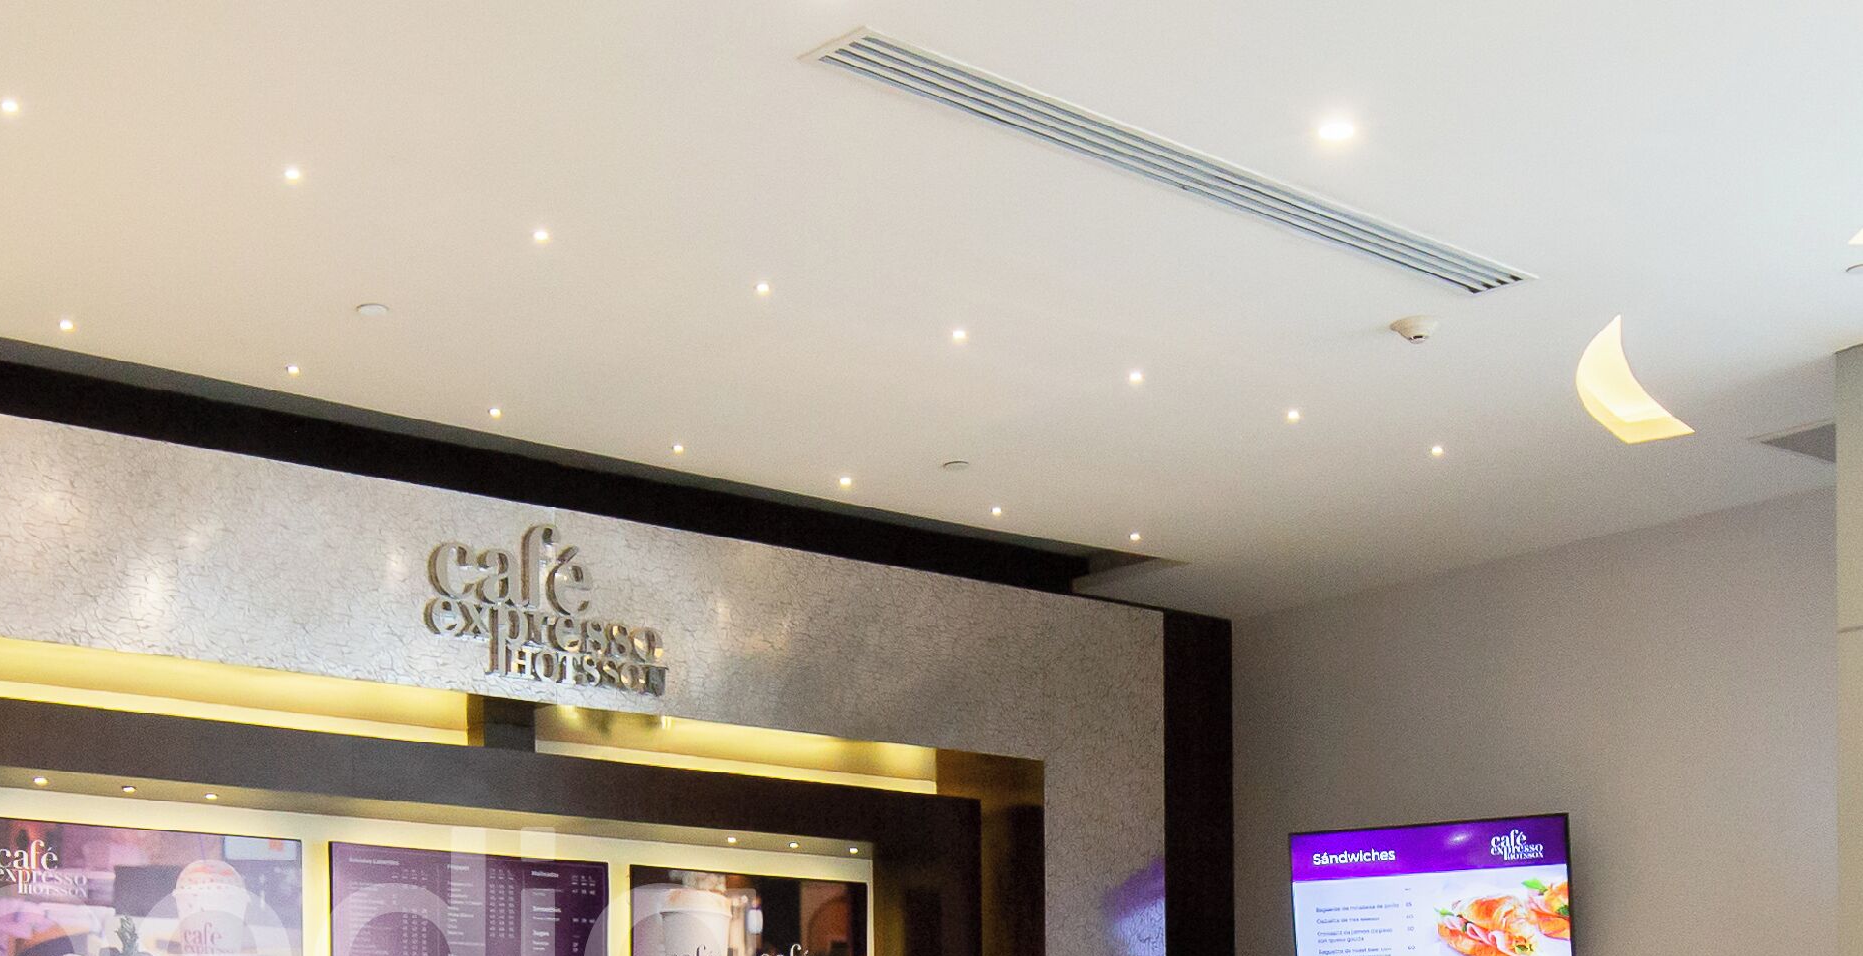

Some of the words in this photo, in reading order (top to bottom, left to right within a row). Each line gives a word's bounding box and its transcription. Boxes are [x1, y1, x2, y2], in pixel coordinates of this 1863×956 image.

[428, 523, 593, 616] café
[423, 596, 664, 677] expresso
[1312, 848, 1396, 866] Sándwiches
